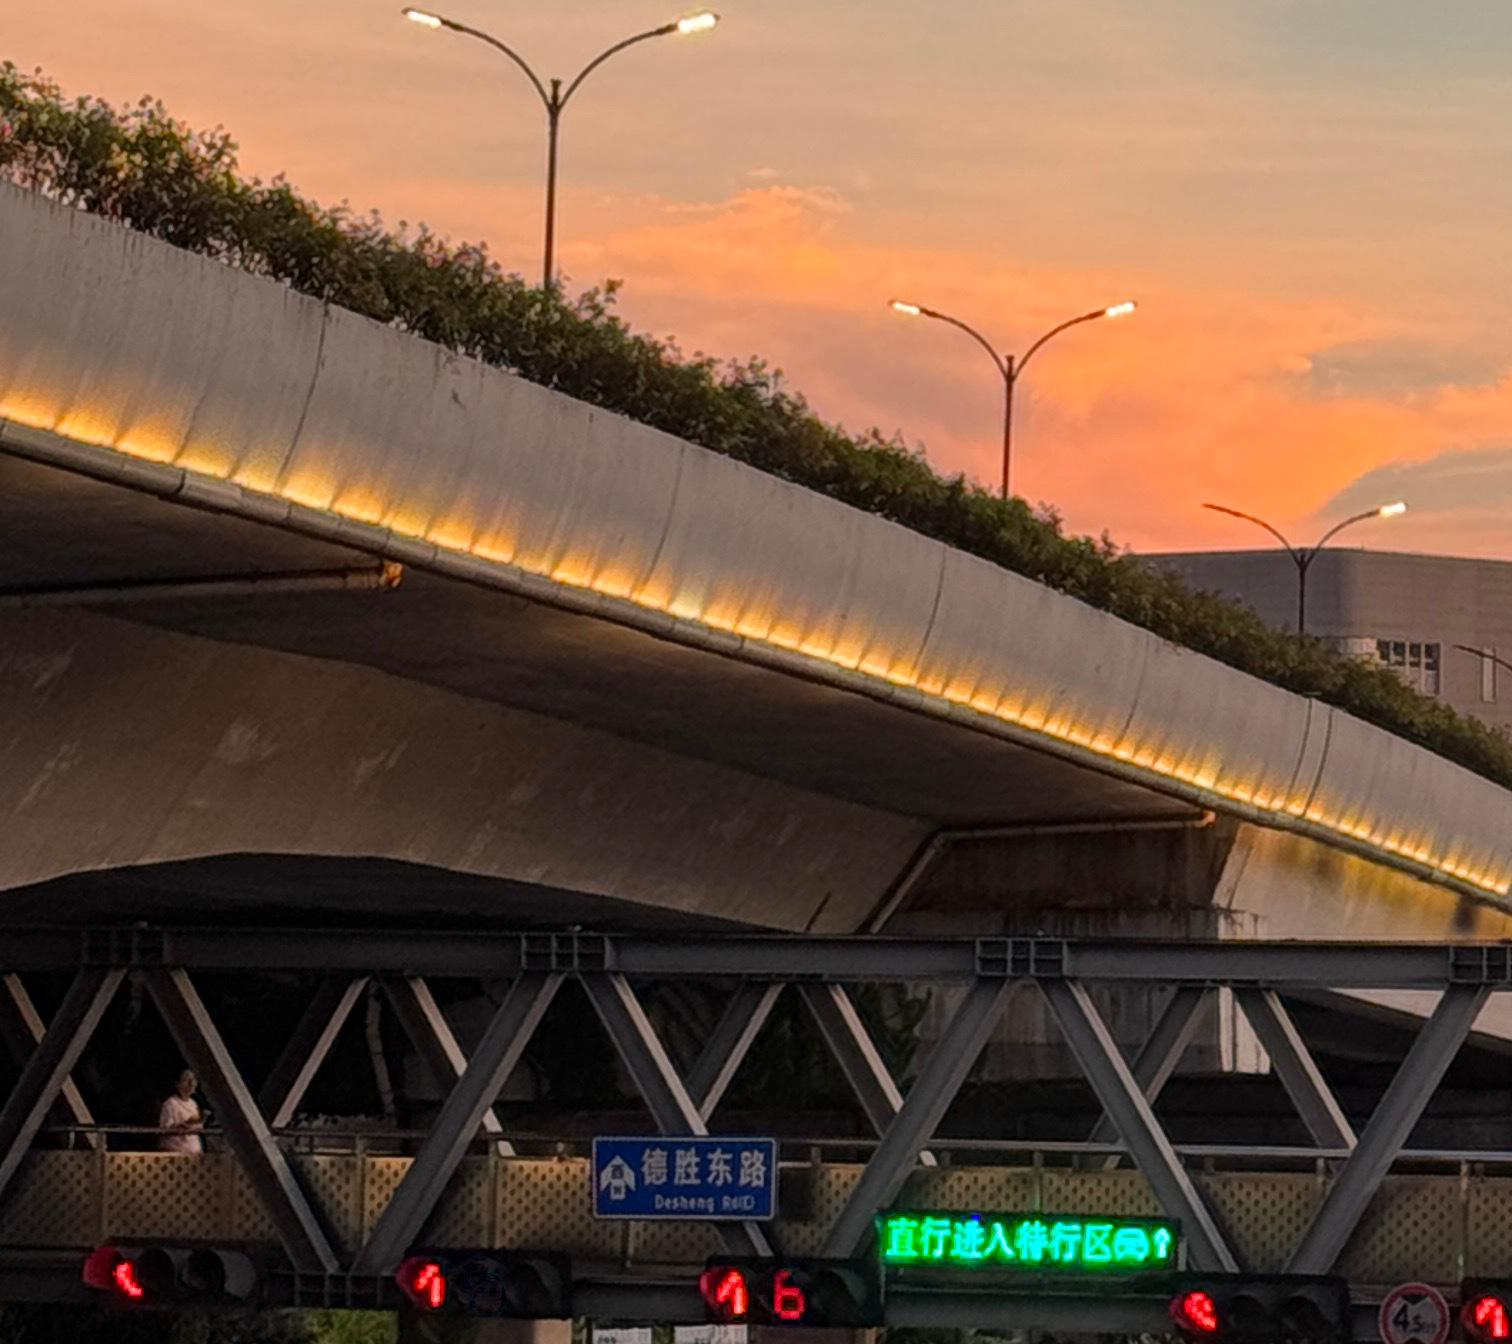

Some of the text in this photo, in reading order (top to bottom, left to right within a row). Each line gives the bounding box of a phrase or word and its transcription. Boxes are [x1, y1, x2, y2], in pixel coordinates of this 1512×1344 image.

[641, 1147, 767, 1188] 德胜东路
[654, 1193, 715, 1213] Desheng
[885, 1217, 1114, 1261] 直行进入待行区
[774, 1269, 806, 1320] 6
